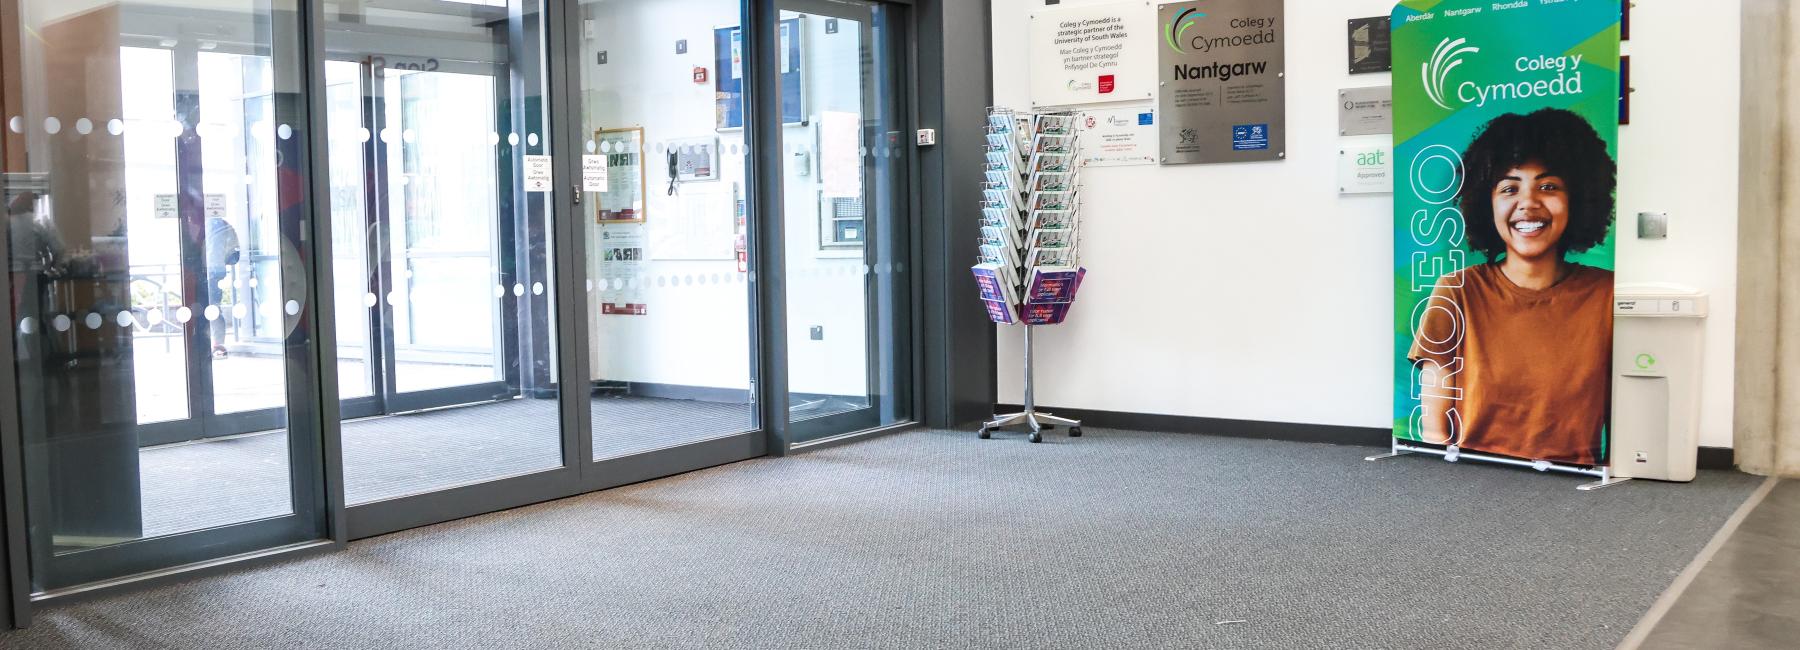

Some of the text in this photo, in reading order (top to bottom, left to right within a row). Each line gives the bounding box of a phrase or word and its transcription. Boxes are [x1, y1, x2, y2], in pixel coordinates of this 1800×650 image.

[1444, 6, 1482, 17] Nantgarw
[1491, 0, 1529, 11] Rhondda
[1060, 21, 1077, 29] Coleg
[1082, 17, 1111, 26] Cymoedd
[1230, 17, 1275, 29] Coleg y
[1054, 36, 1083, 45] University
[1091, 33, 1109, 41] South
[1057, 28, 1082, 37] strategic
[1083, 27, 1105, 35] partner
[1094, 43, 1122, 52] Cymoedd
[1191, 29, 1275, 53] Cymoedd
[1098, 60, 1118, 68] Cymru
[1174, 61, 1267, 81] Nantgarw
[1515, 54, 1583, 72] Coleg y
[1457, 72, 1583, 107] Cymoedd
[1357, 149, 1385, 166] aat
[1409, 144, 1466, 447] CROESO
